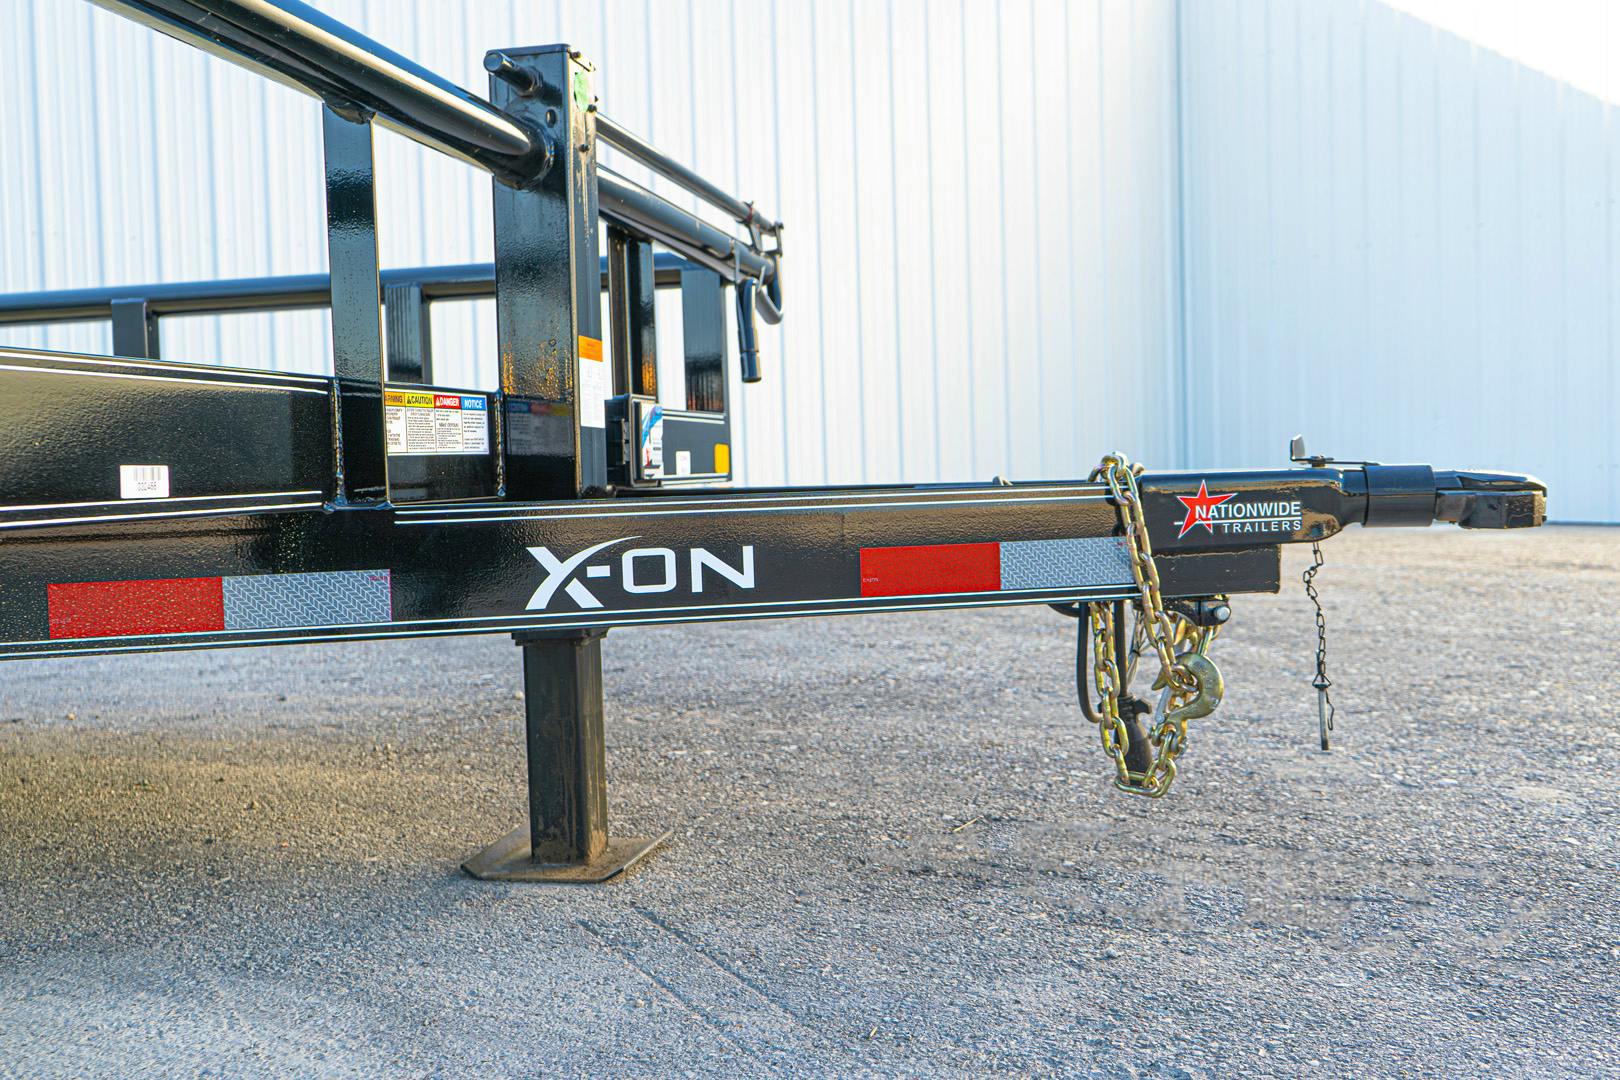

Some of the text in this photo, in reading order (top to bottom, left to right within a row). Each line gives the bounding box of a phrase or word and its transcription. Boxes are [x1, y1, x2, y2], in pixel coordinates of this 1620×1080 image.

[411, 395, 433, 405] CAUTION
[439, 396, 460, 407] DANGER
[464, 399, 483, 409] NOTICE
[1195, 501, 1302, 520] NATIONWIDE
[1222, 520, 1302, 534] TRAILERS
[524, 535, 756, 611] X-ON
